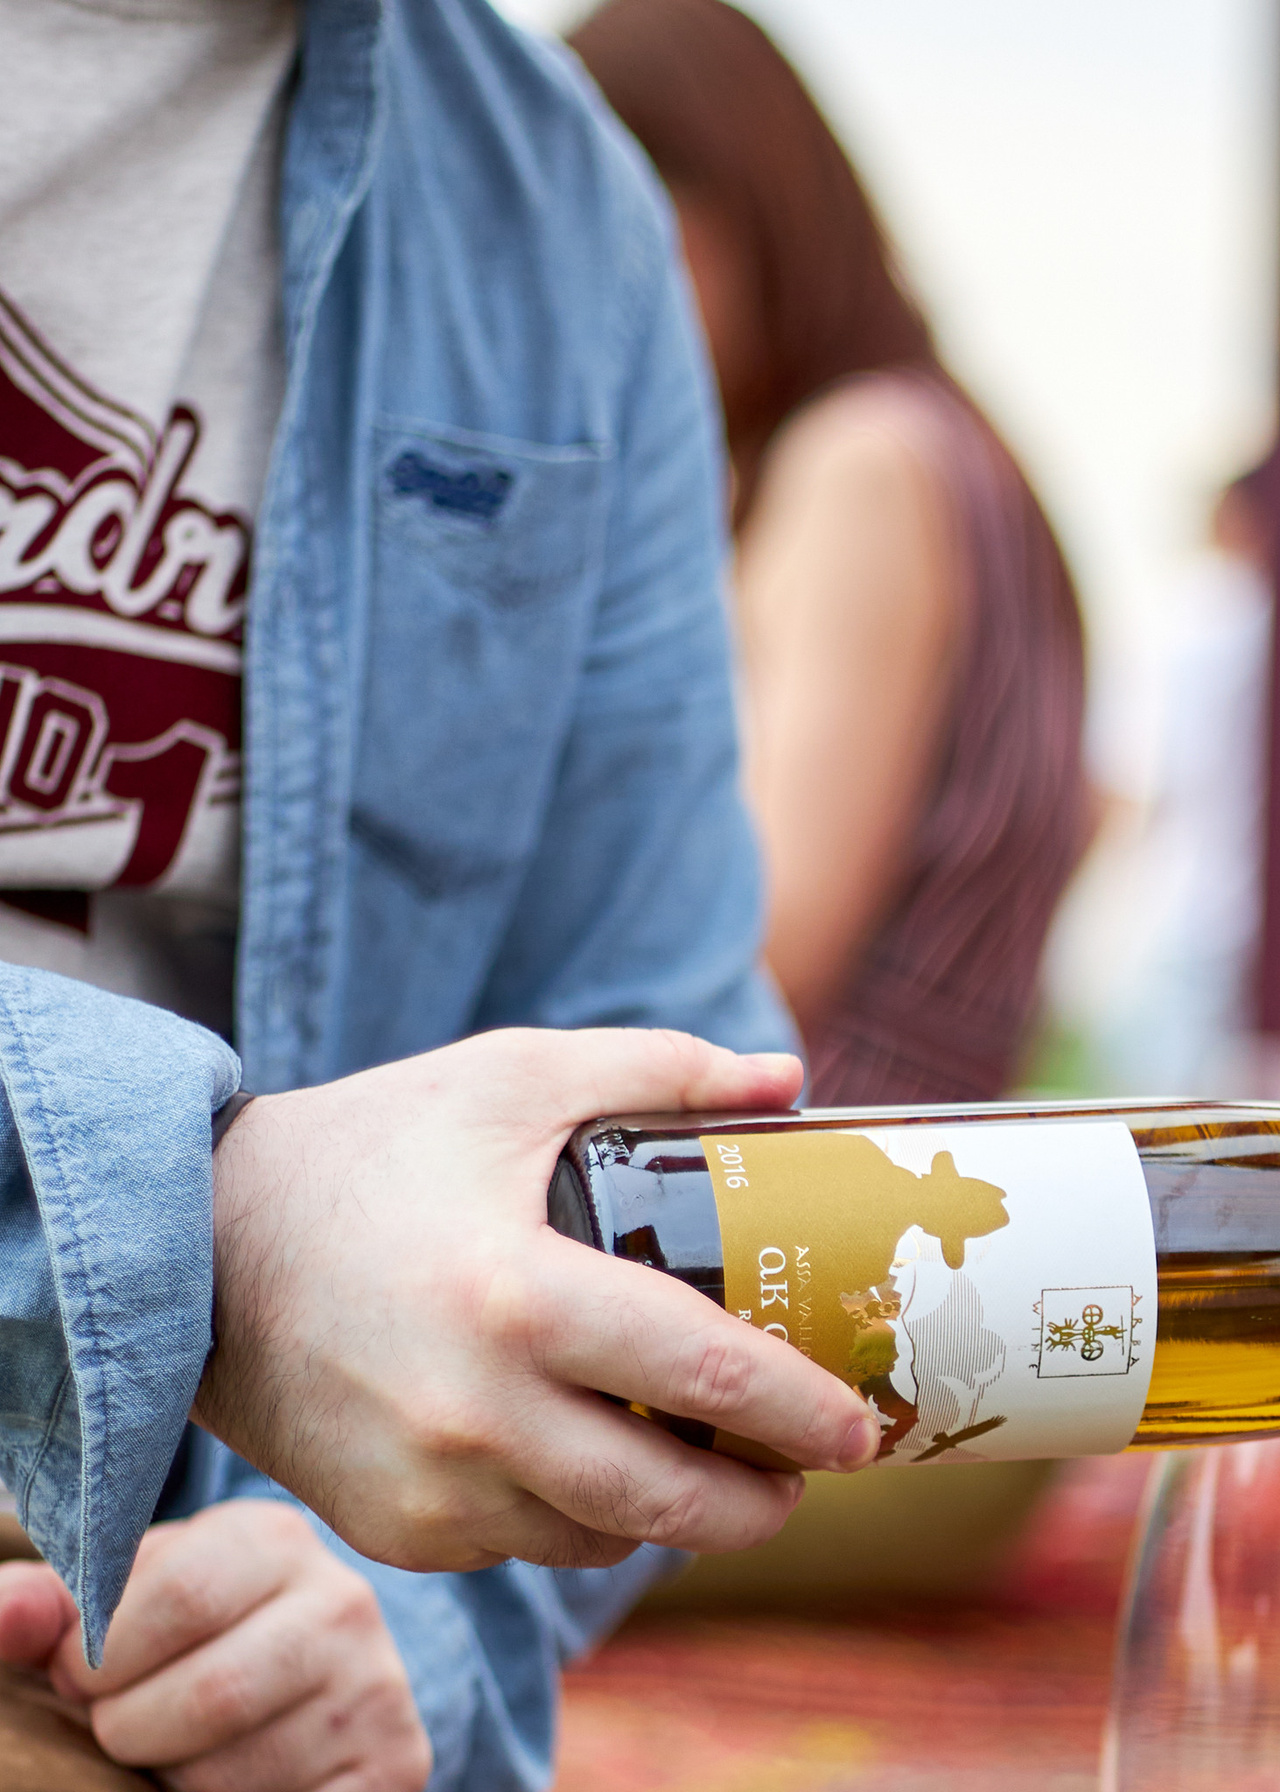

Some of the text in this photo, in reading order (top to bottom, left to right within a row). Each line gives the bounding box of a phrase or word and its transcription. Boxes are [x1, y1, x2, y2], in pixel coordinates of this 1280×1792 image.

[716, 1144, 749, 1189] 2016
[795, 1245, 812, 1293] ASSA
[1029, 1301, 1041, 1369] WINE
